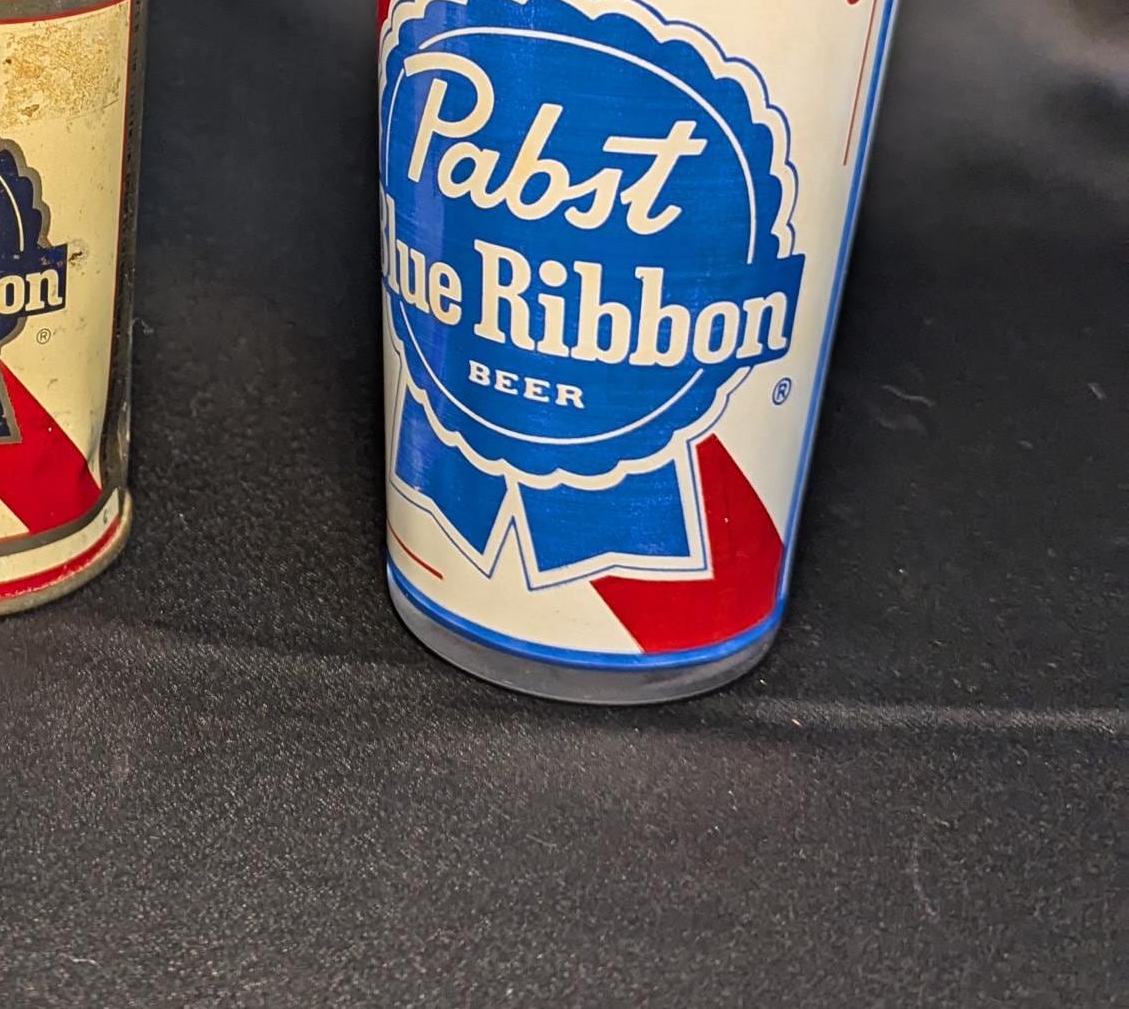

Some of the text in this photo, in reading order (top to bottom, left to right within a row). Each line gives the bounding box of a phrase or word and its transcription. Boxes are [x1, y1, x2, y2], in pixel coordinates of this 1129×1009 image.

[403, 51, 707, 236] Pabst
[382, 192, 788, 367] lue Ribbon
[468, 360, 585, 409] BEER
